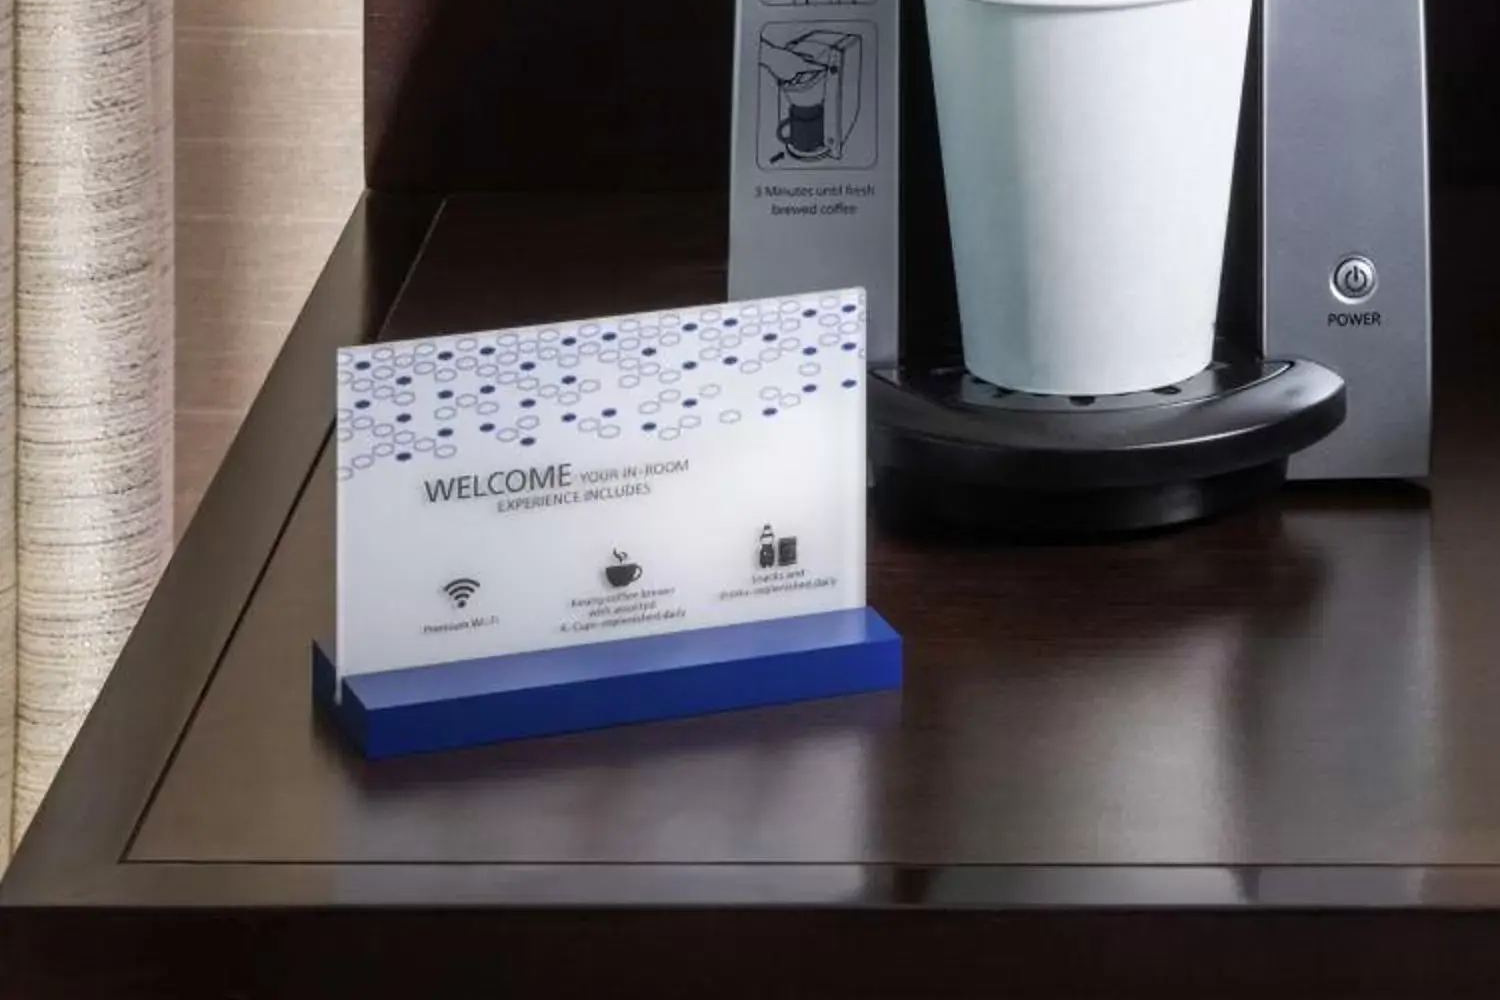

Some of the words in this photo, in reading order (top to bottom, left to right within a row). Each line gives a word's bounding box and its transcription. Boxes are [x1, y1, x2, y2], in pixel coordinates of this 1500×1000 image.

[765, 185, 814, 197] Minutes
[770, 203, 817, 215] brewed
[820, 202, 859, 215] coffee
[1327, 311, 1381, 327] POWER
[424, 463, 573, 502] WELCOME
[578, 467, 619, 484] YOUR
[621, 458, 690, 478] IN-ROOM
[496, 490, 580, 514] EXPERIENCE
[582, 482, 652, 503] INCLUDES
